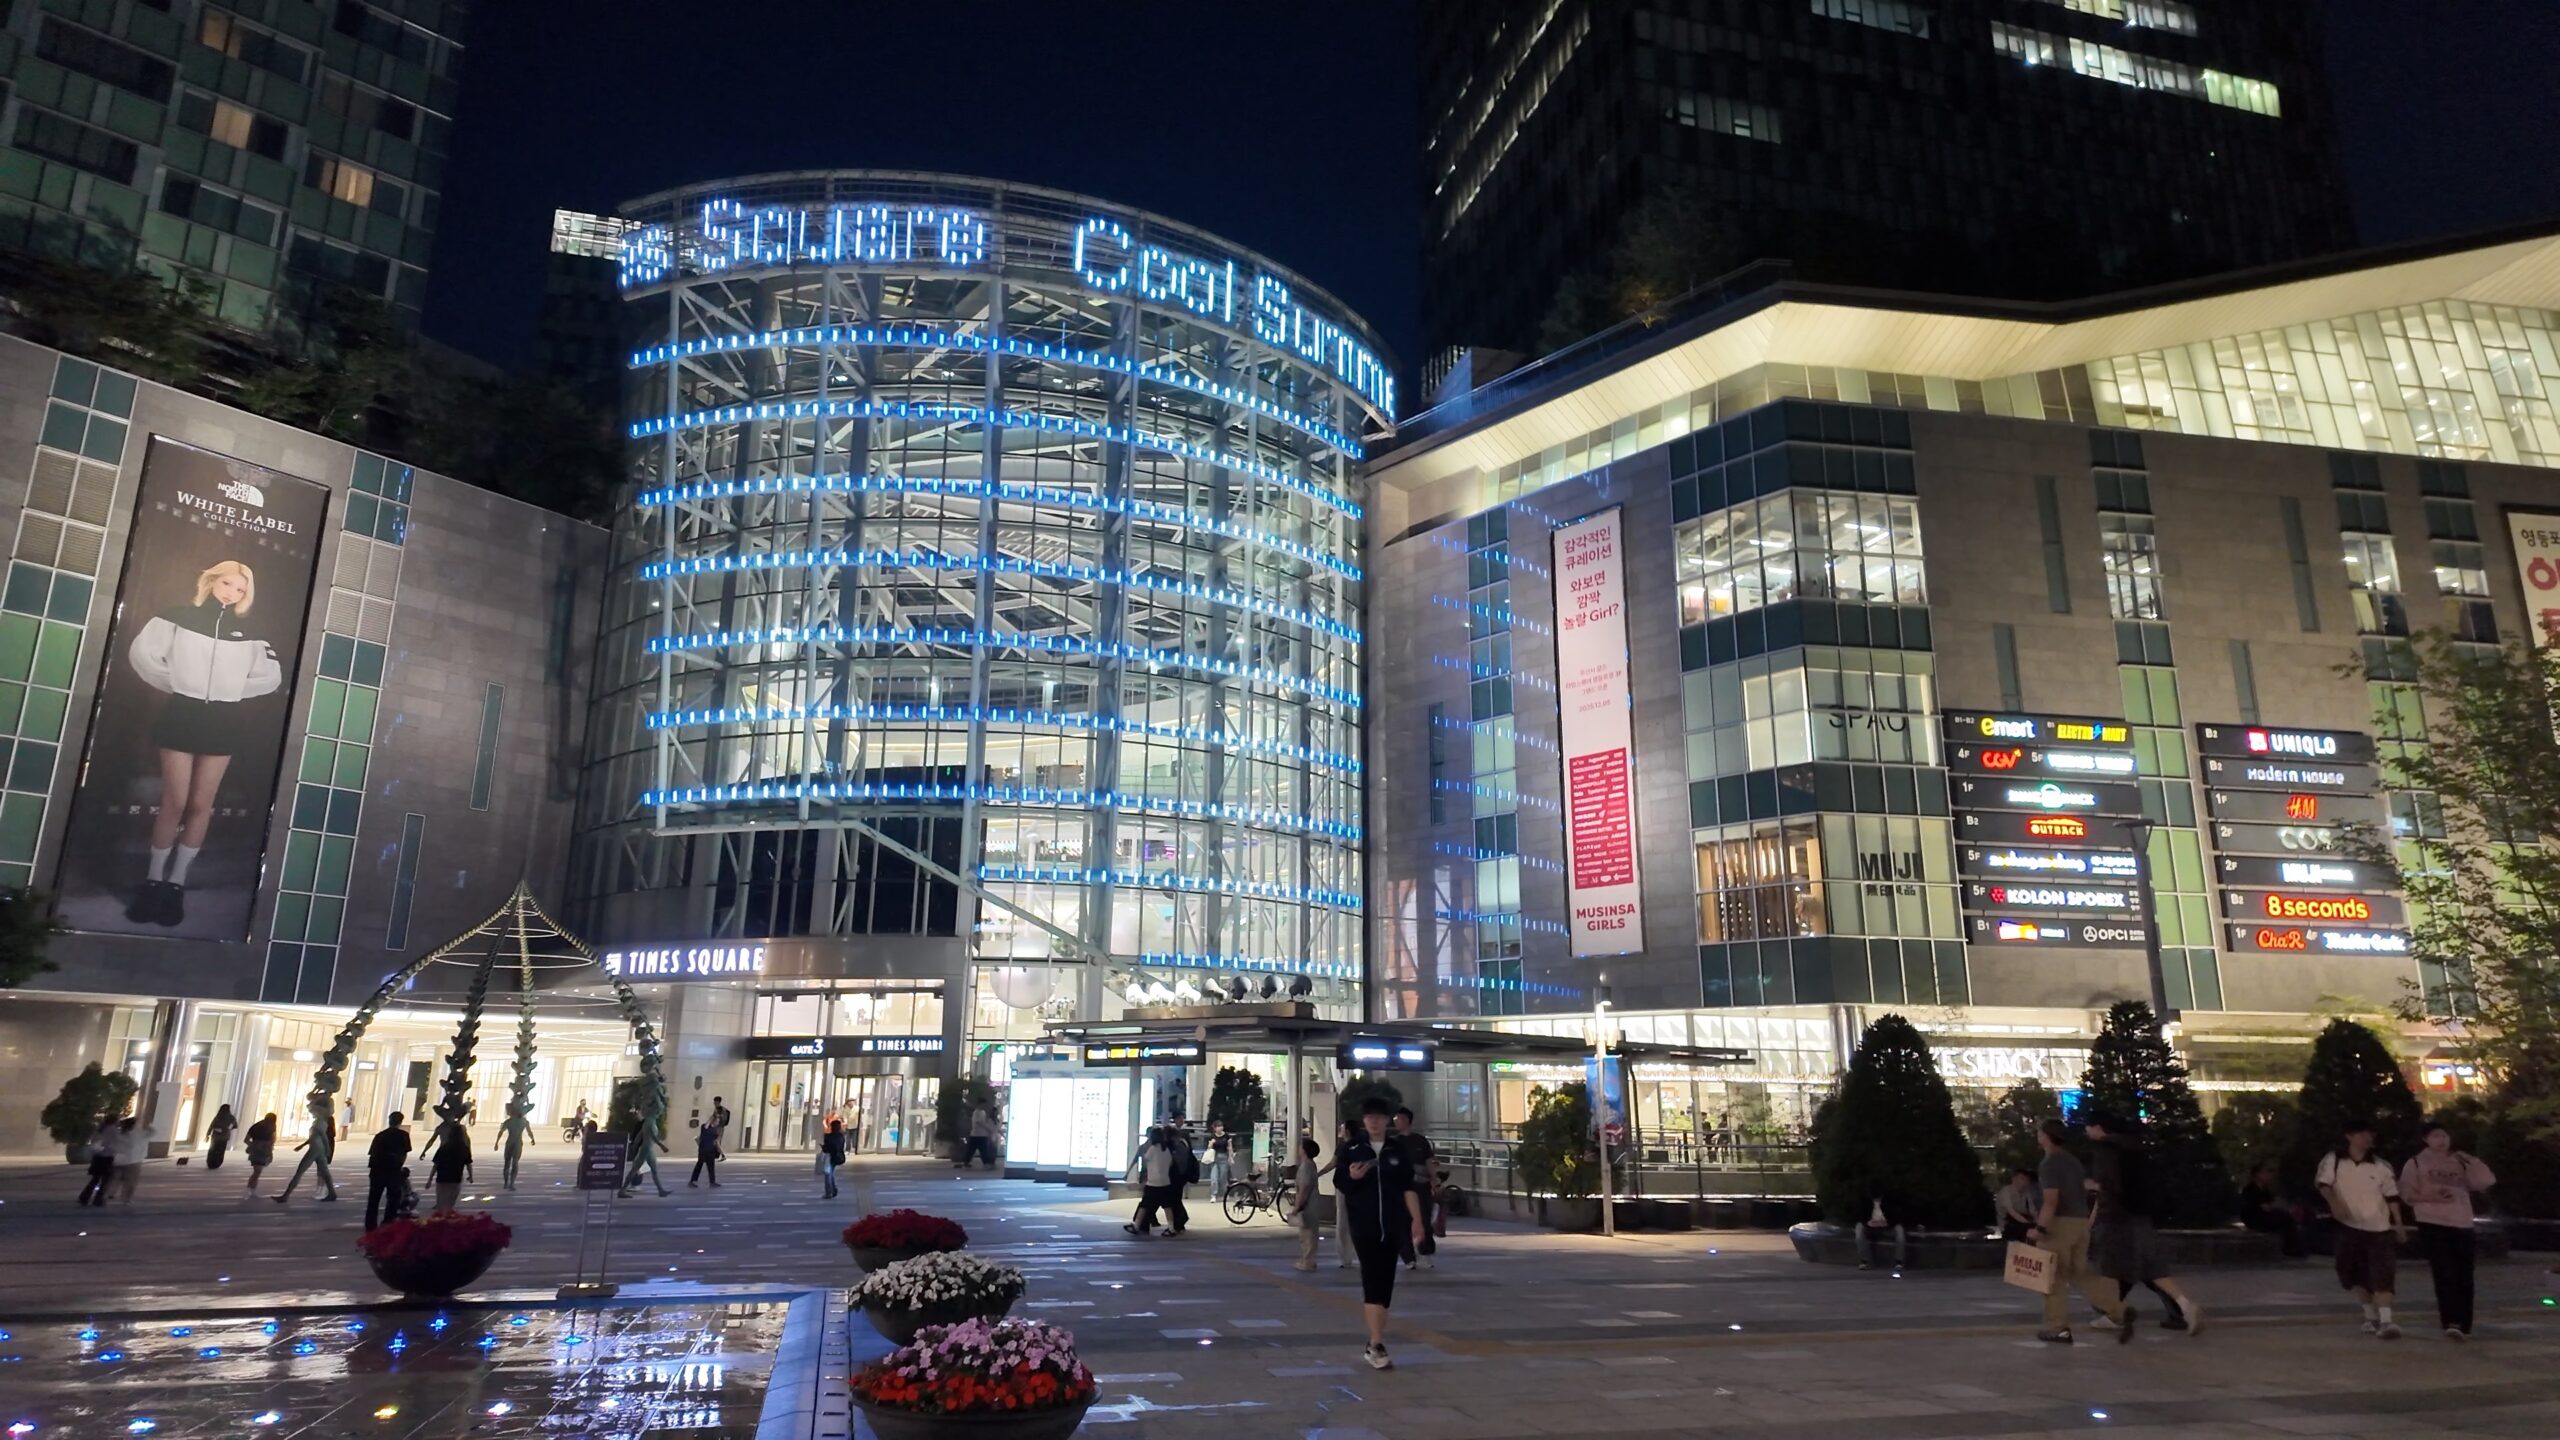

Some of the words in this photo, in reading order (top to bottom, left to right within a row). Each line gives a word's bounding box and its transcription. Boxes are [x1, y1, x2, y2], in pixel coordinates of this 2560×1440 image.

[1073, 218, 1234, 323] Cool
[217, 483, 249, 497] NORTH
[232, 480, 250, 490] THE
[225, 490, 249, 503] FACE
[177, 490, 237, 518] WHITE
[241, 509, 296, 535] LABEL
[203, 512, 267, 534] COLLECTION
[1565, 526, 1611, 553] 감각적인
[1566, 543, 1612, 570] 큐레이션
[1570, 570, 1606, 593] 와보면
[1577, 590, 1602, 609] 깜짝
[1589, 603, 1619, 622] Girl?
[1981, 717, 2036, 738] emart
[2205, 728, 2218, 739] B2
[2270, 733, 2337, 756] UNIQLO
[1958, 748, 1970, 758] 4F
[1982, 750, 2017, 768] CGV
[2031, 752, 2044, 763] 5F
[2209, 760, 2222, 771] B2
[1962, 782, 1974, 792] 1F
[2215, 793, 2227, 804] 1F
[1966, 816, 1979, 826] B2
[2031, 824, 2084, 836] OUTBACK
[2220, 826, 2233, 837] 2F
[2279, 827, 2333, 850] COS
[1968, 850, 1980, 860] 5F
[1860, 852, 1921, 880] MUJI
[2225, 859, 2238, 871] 2F
[1973, 885, 1985, 896] 5F
[2006, 889, 2065, 905] KOLON
[1576, 903, 1636, 919] MUSINSA
[2267, 895, 2282, 916] 8
[2283, 898, 2369, 919] seconds
[1587, 918, 1626, 931] GIRLS
[1977, 920, 1990, 930] B1
[2235, 927, 2247, 939] 1F
[629, 949, 681, 974] TIMES
[687, 947, 765, 975] SQUARE
[791, 1045, 814, 1055] GATE
[813, 1038, 824, 1054] 3
[877, 1039, 906, 1051] TIMES
[1961, 1048, 2049, 1078] SHACK
